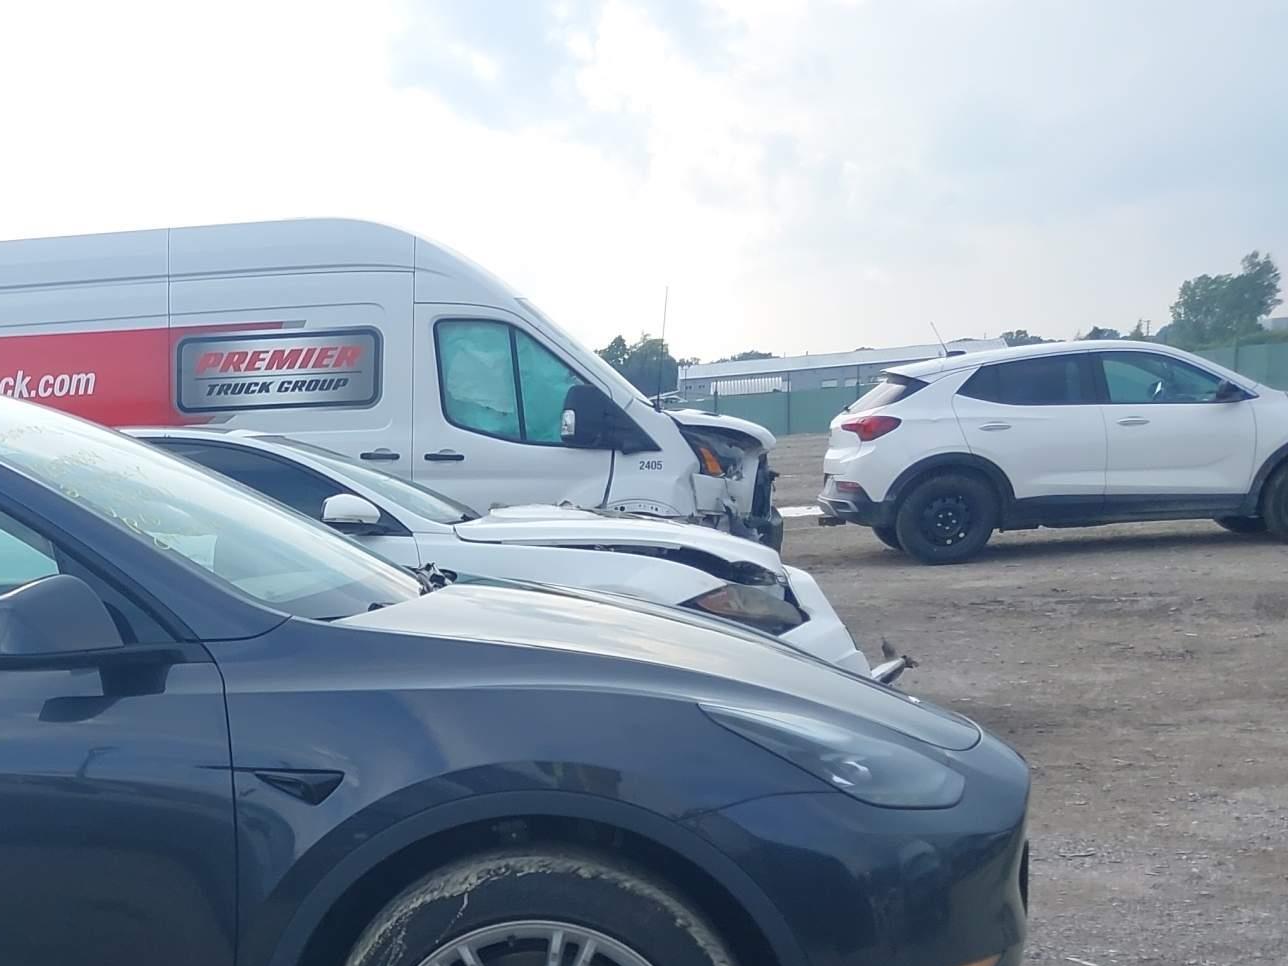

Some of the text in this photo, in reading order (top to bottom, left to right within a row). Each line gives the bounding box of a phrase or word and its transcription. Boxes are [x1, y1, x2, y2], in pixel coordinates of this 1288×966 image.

[194, 345, 365, 374] PREMIER
[206, 377, 350, 397] TRUCK GROUP
[639, 460, 663, 471] 2405
